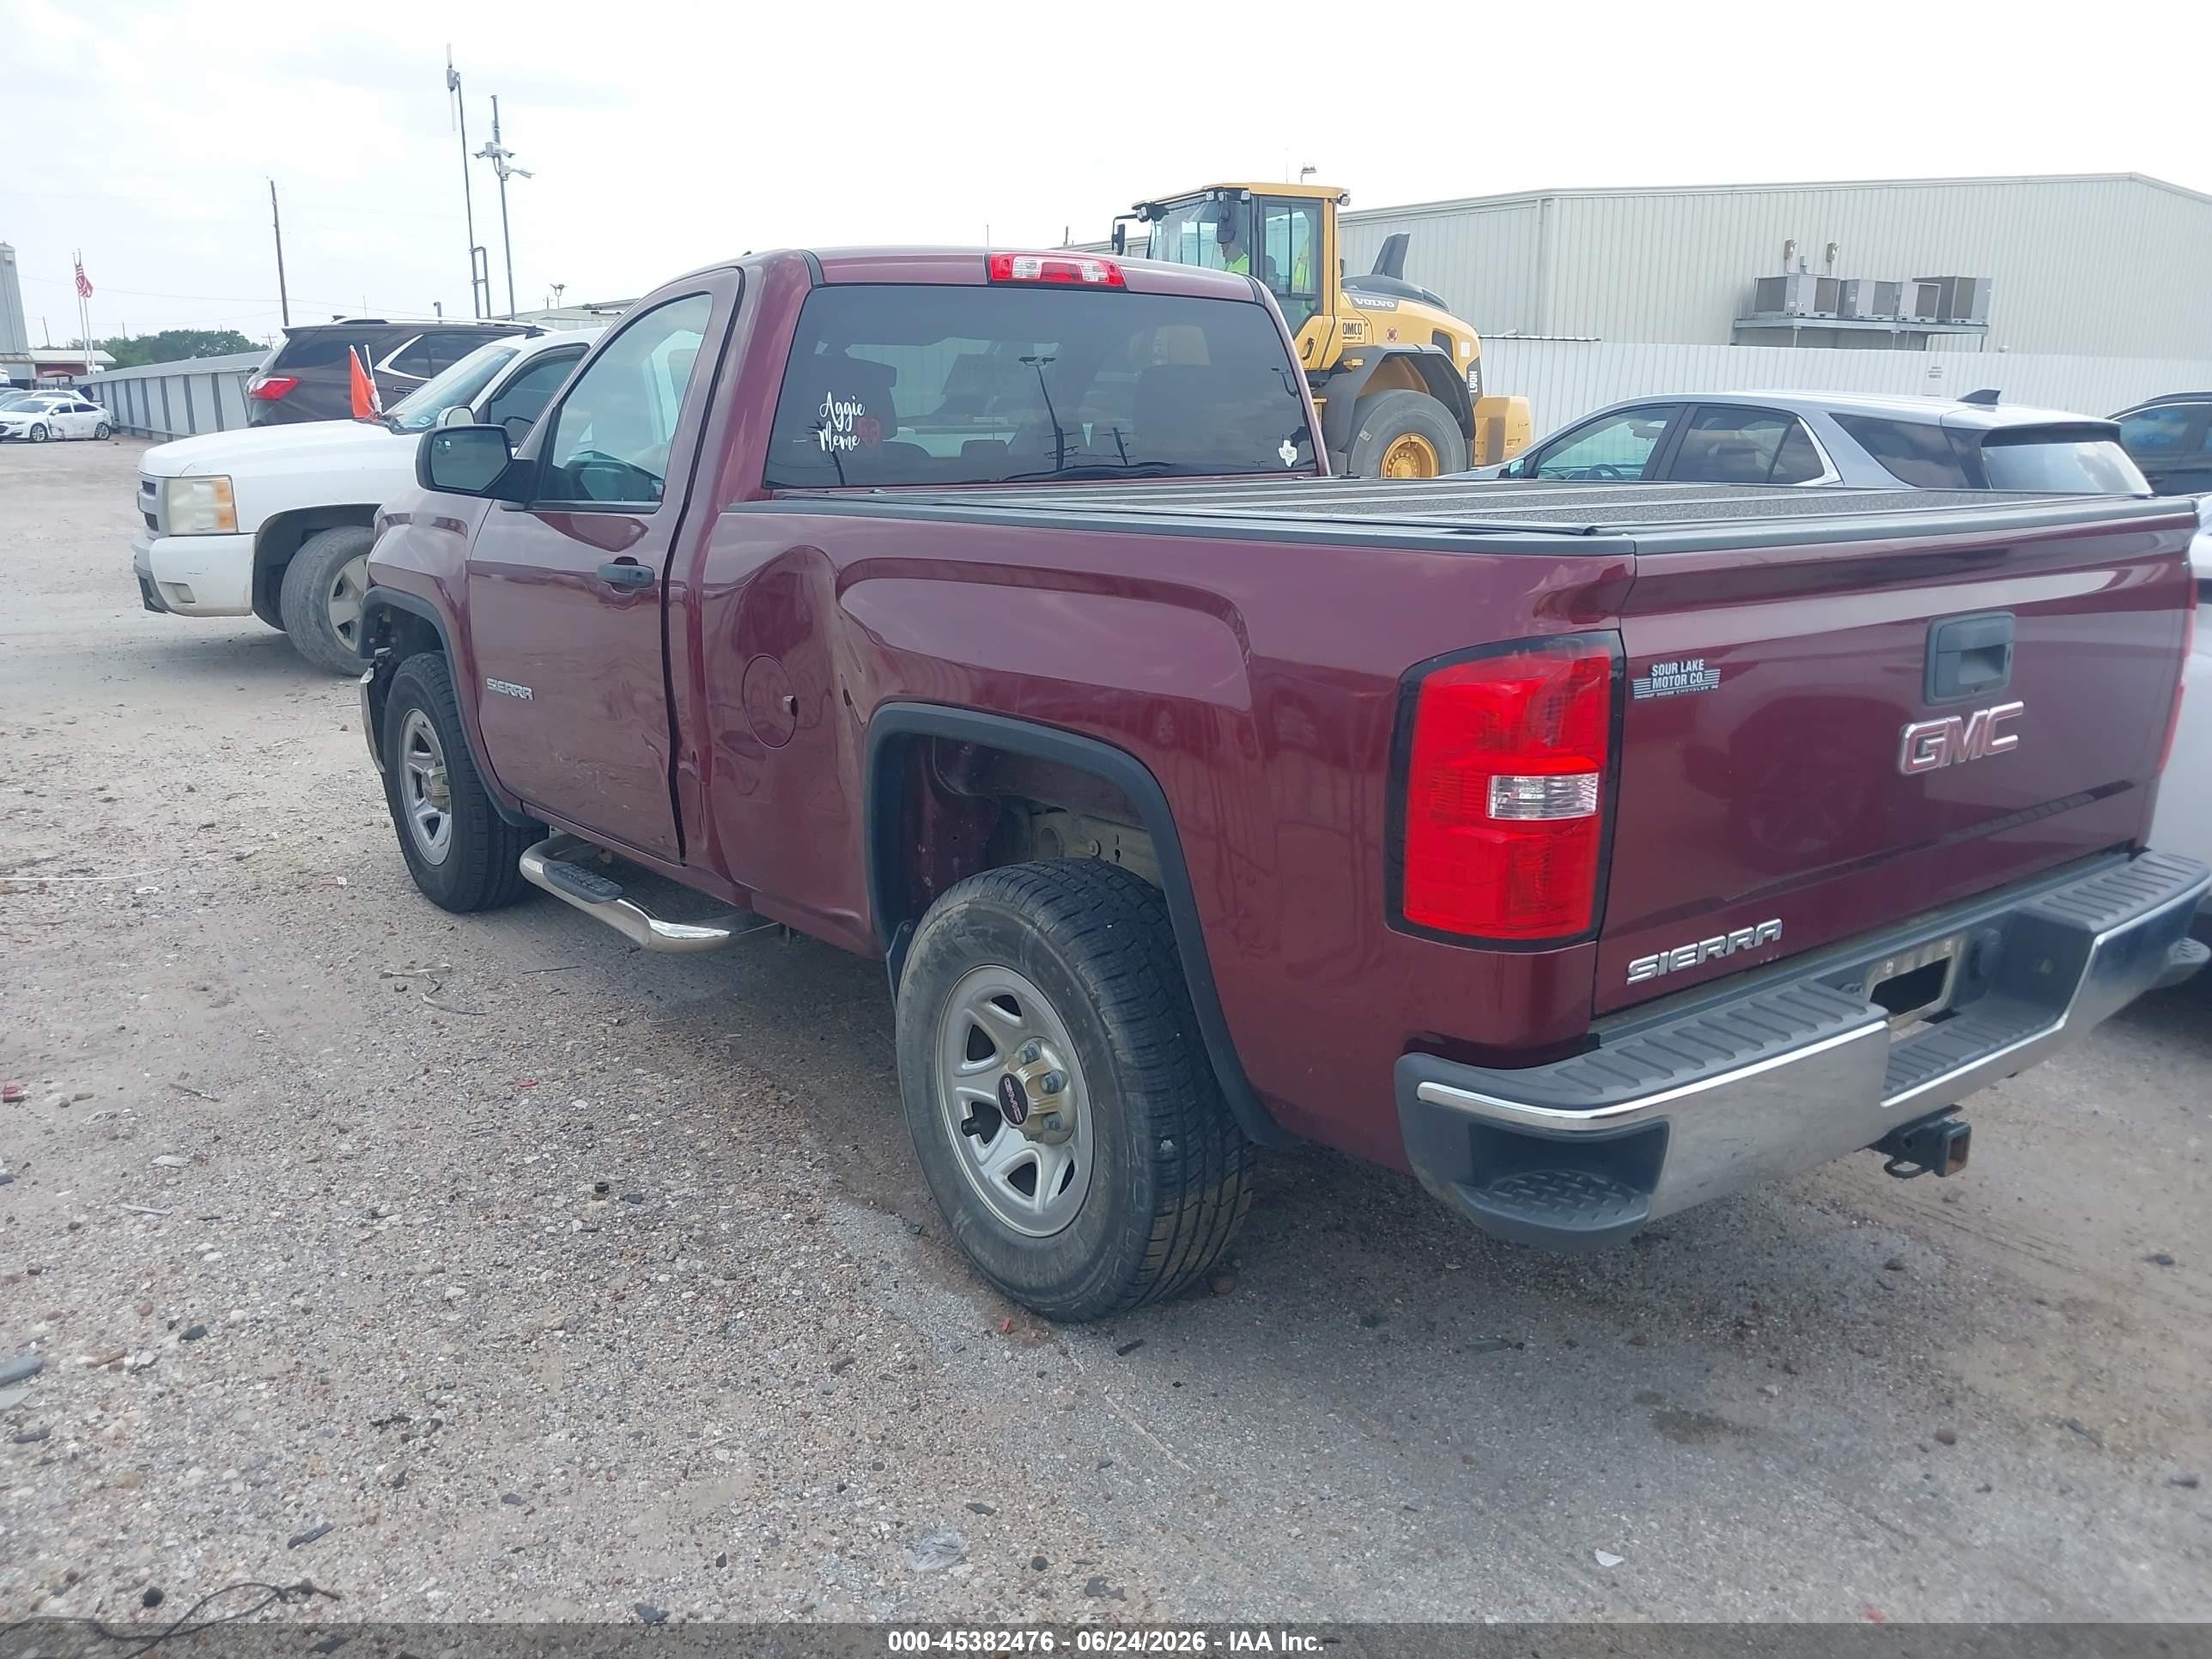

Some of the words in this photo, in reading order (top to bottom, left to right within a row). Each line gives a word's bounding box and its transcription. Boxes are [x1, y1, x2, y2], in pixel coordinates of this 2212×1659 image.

[1353, 297, 1395, 308] VOLVO
[1342, 322, 1363, 336] OMCO
[1468, 370, 1478, 393] L90H
[819, 391, 866, 432] Aggie
[817, 420, 860, 453] Meme
[1651, 662, 1679, 677] SOUR
[1680, 659, 1705, 673] LAKE
[486, 678, 533, 701] SIERRA
[1652, 673, 1687, 690] MOTOR
[1900, 701, 2025, 775] GMC
[1626, 918, 1783, 985] SIERRA
[1004, 1077, 1024, 1122] GMC
